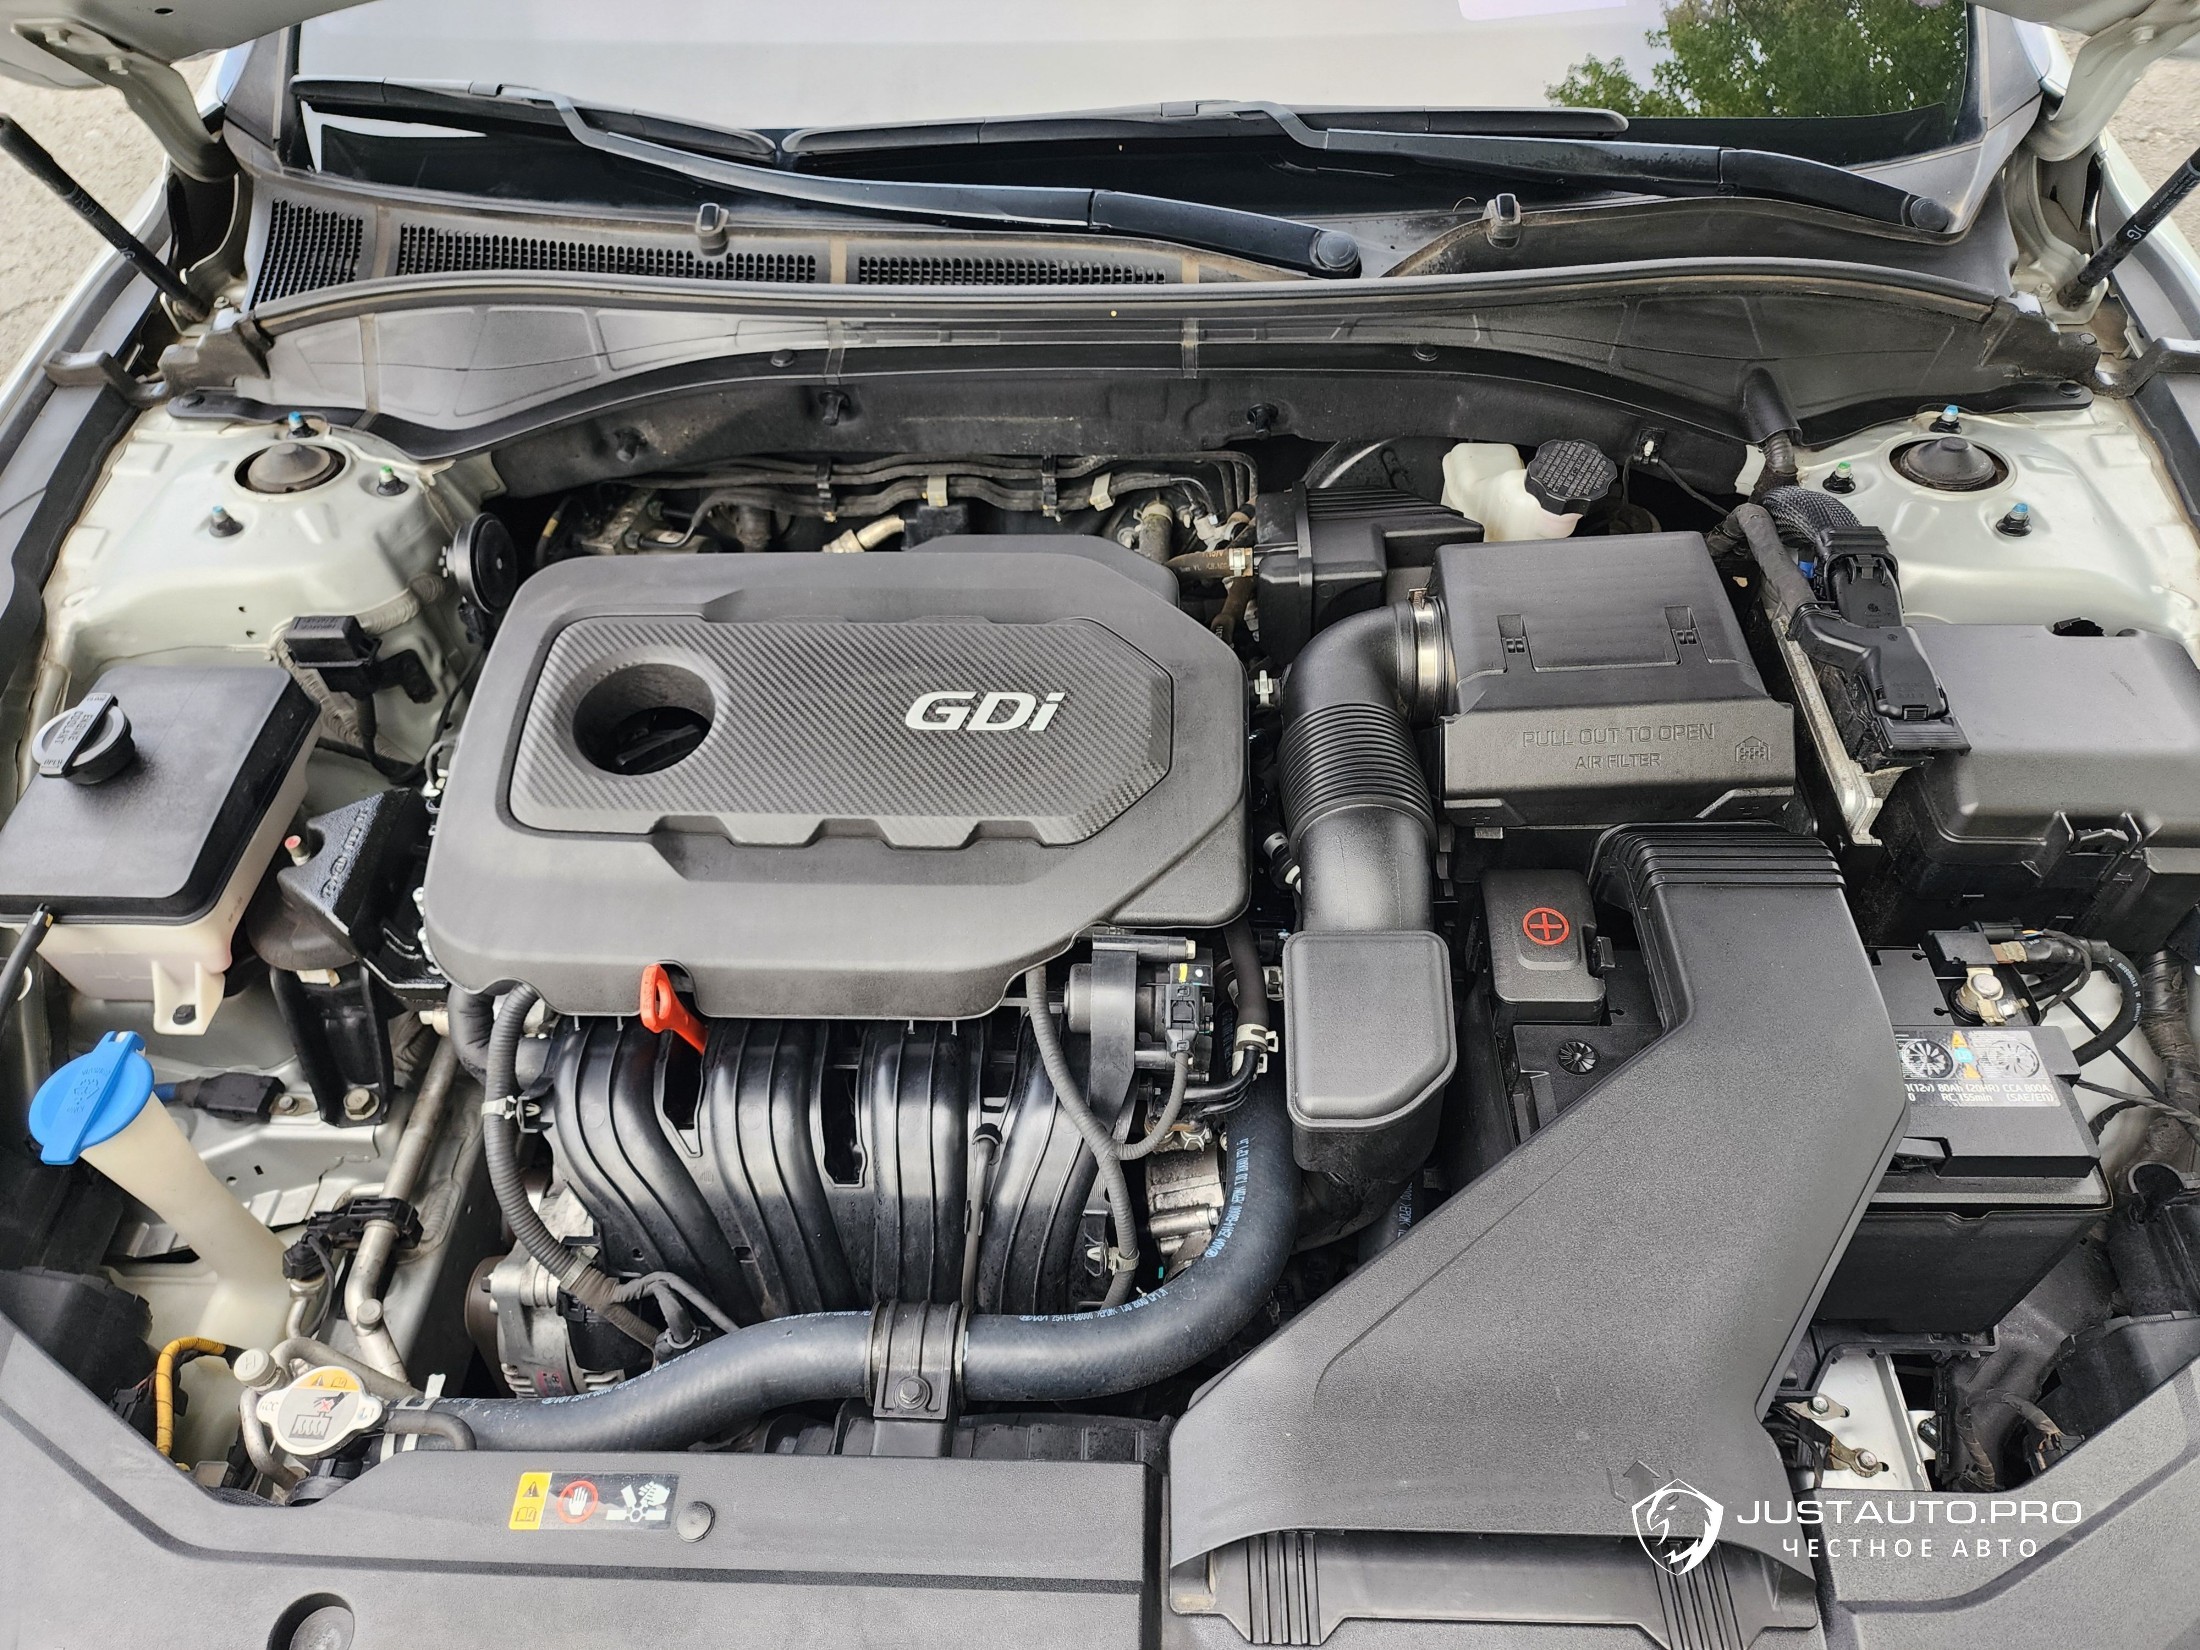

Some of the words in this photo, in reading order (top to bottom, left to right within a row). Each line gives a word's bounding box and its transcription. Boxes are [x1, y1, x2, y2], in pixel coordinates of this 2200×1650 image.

[905, 690, 1066, 731] GDi
[1522, 730, 1574, 748] PULL
[1579, 727, 1620, 745] OUT
[1626, 726, 1653, 743] TO
[1658, 723, 1715, 742] OPEN
[1574, 756, 1602, 770] AIR
[1607, 753, 1661, 769] FILTER
[1937, 1083, 1963, 1093] 80Ah
[1966, 1083, 2000, 1093] (20HR)
[2002, 1083, 2024, 1093] CCA
[2024, 1083, 2051, 1093] 800A
[1941, 1092, 1955, 1102] RC
[1956, 1092, 1993, 1102] 155min
